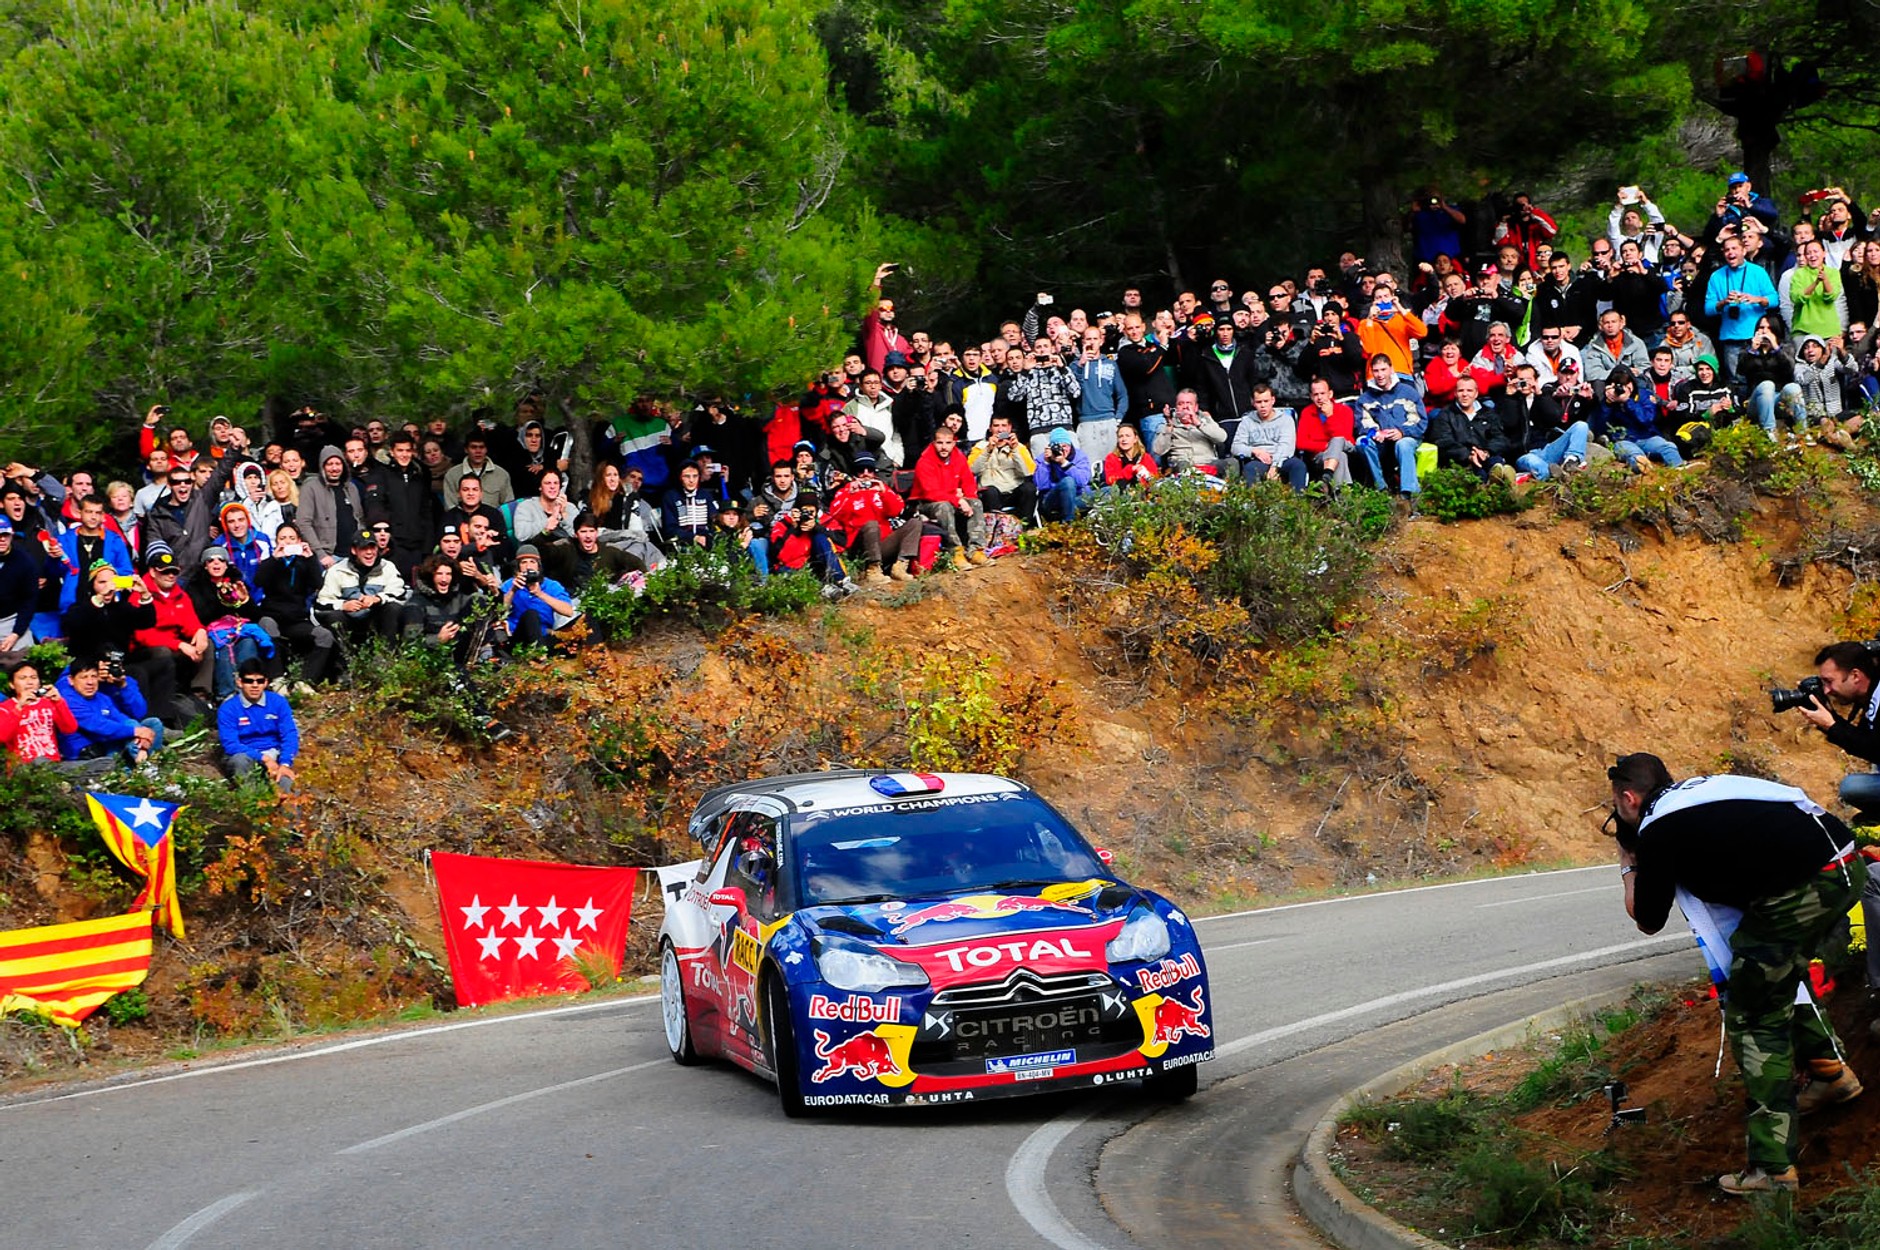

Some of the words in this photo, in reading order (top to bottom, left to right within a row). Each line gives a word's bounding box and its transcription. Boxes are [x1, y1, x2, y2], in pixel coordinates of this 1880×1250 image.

[832, 804, 895, 817] WORLD
[898, 794, 1000, 810] CHAMPIONS
[712, 893, 735, 901] TOTAL
[734, 932, 756, 972] RACC
[935, 938, 1092, 972] TOTAL
[690, 962, 722, 996] TOTAL
[1009, 1052, 1071, 1067] MICHELIN
[1106, 1067, 1153, 1082] LUHTA
[804, 1094, 889, 1106] EURODATACAR
[919, 1091, 974, 1103] LUHTA
